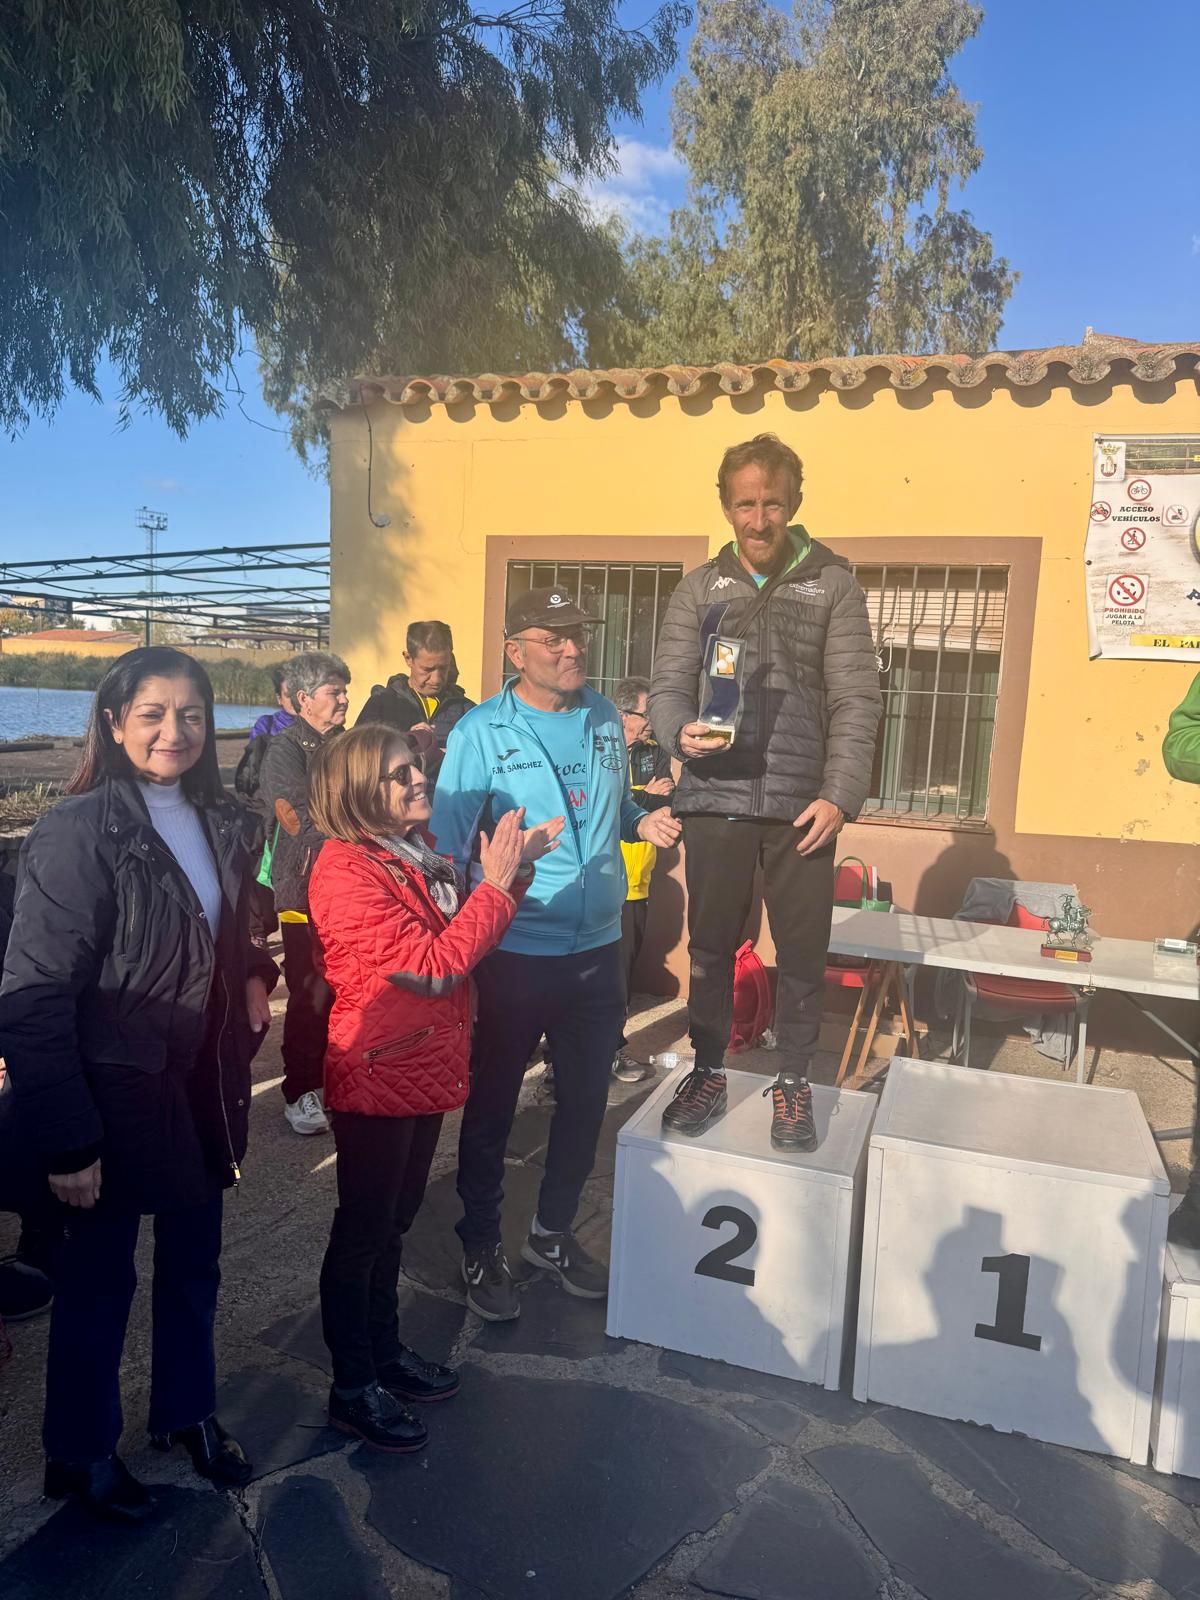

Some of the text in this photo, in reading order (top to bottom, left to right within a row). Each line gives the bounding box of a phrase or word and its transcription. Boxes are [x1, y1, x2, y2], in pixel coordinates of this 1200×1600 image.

[1153, 639, 1170, 647] EL
[492, 766, 506, 775] F.M.
[694, 1205, 758, 1287] 2
[974, 1253, 1042, 1352] 1
